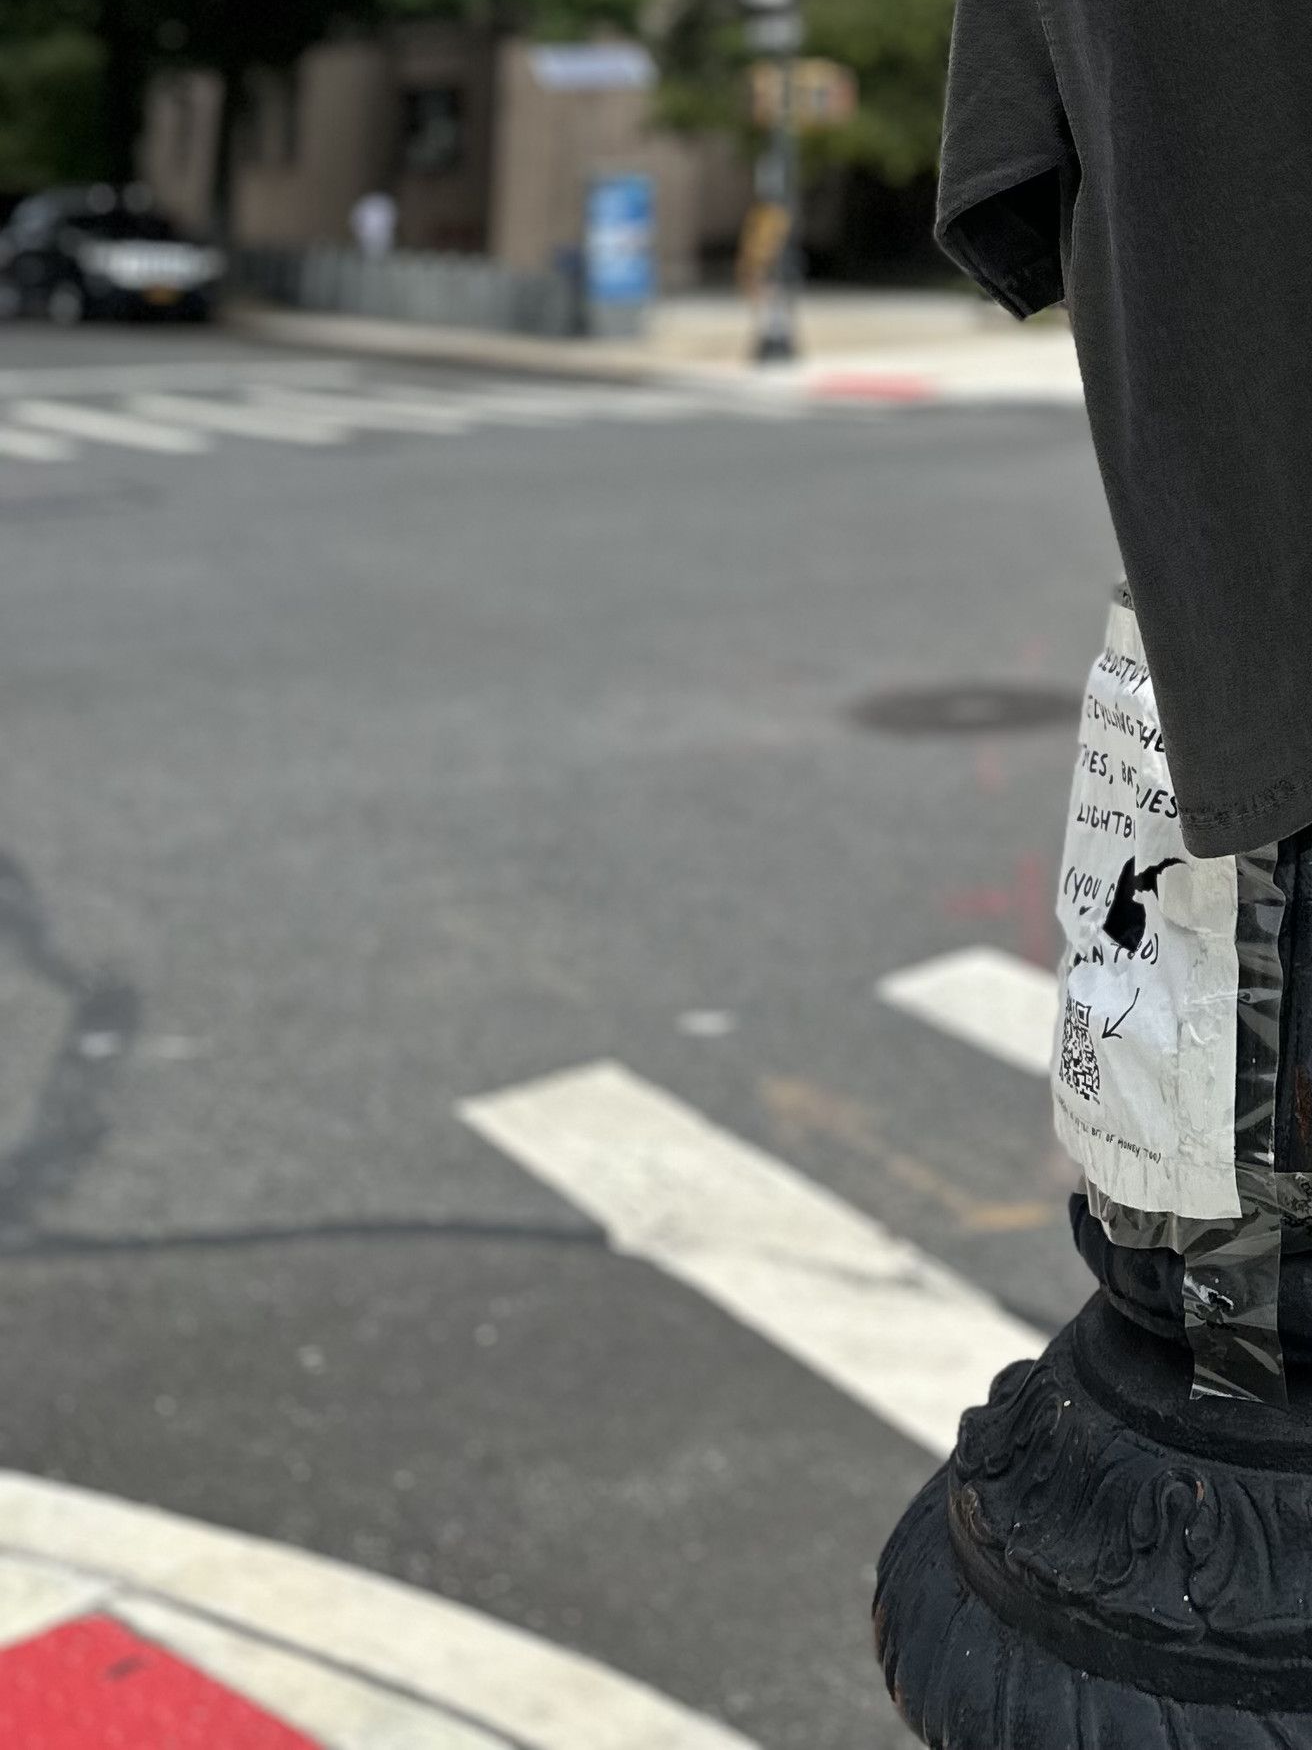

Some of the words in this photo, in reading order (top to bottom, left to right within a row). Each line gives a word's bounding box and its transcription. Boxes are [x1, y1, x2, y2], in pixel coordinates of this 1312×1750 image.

[1064, 866, 1102, 904] (YOU
[1105, 1133, 1116, 1143] OF
[1117, 1137, 1140, 1158] MONEY
